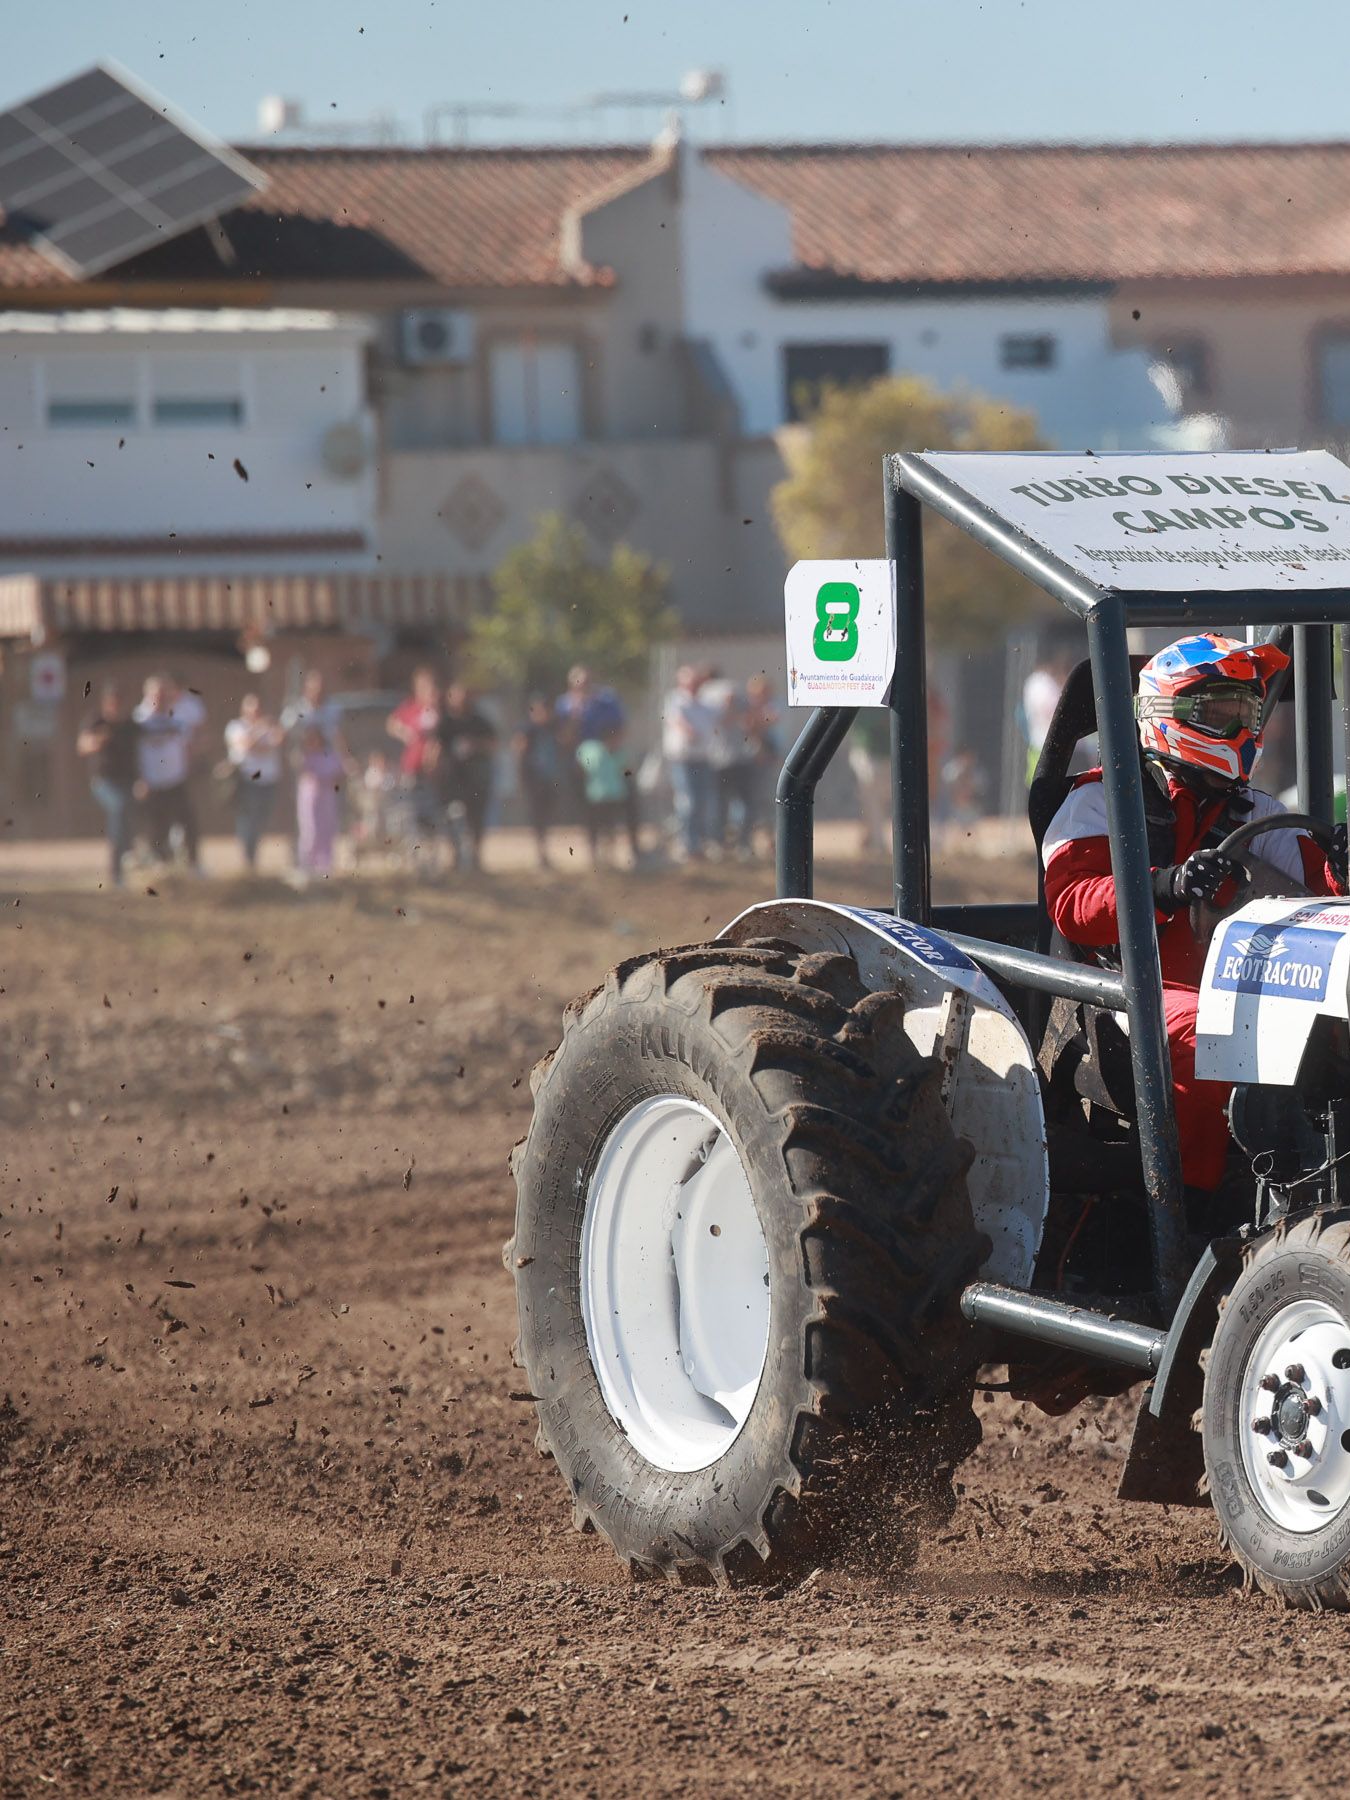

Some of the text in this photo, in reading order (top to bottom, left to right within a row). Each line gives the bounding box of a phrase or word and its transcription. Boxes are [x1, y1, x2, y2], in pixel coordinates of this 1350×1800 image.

[1009, 475, 1162, 507] TURBO
[1112, 507, 1330, 533] CAMPOS
[1152, 545, 1182, 562] de
[1175, 545, 1229, 567] equipo
[1219, 545, 1249, 563] de
[1298, 543, 1350, 561] diesel
[813, 582, 860, 661] 8
[800, 672, 839, 683] Ayuntamiento
[841, 673, 849, 681] de
[1222, 956, 1323, 990] ECOTRACTOR
